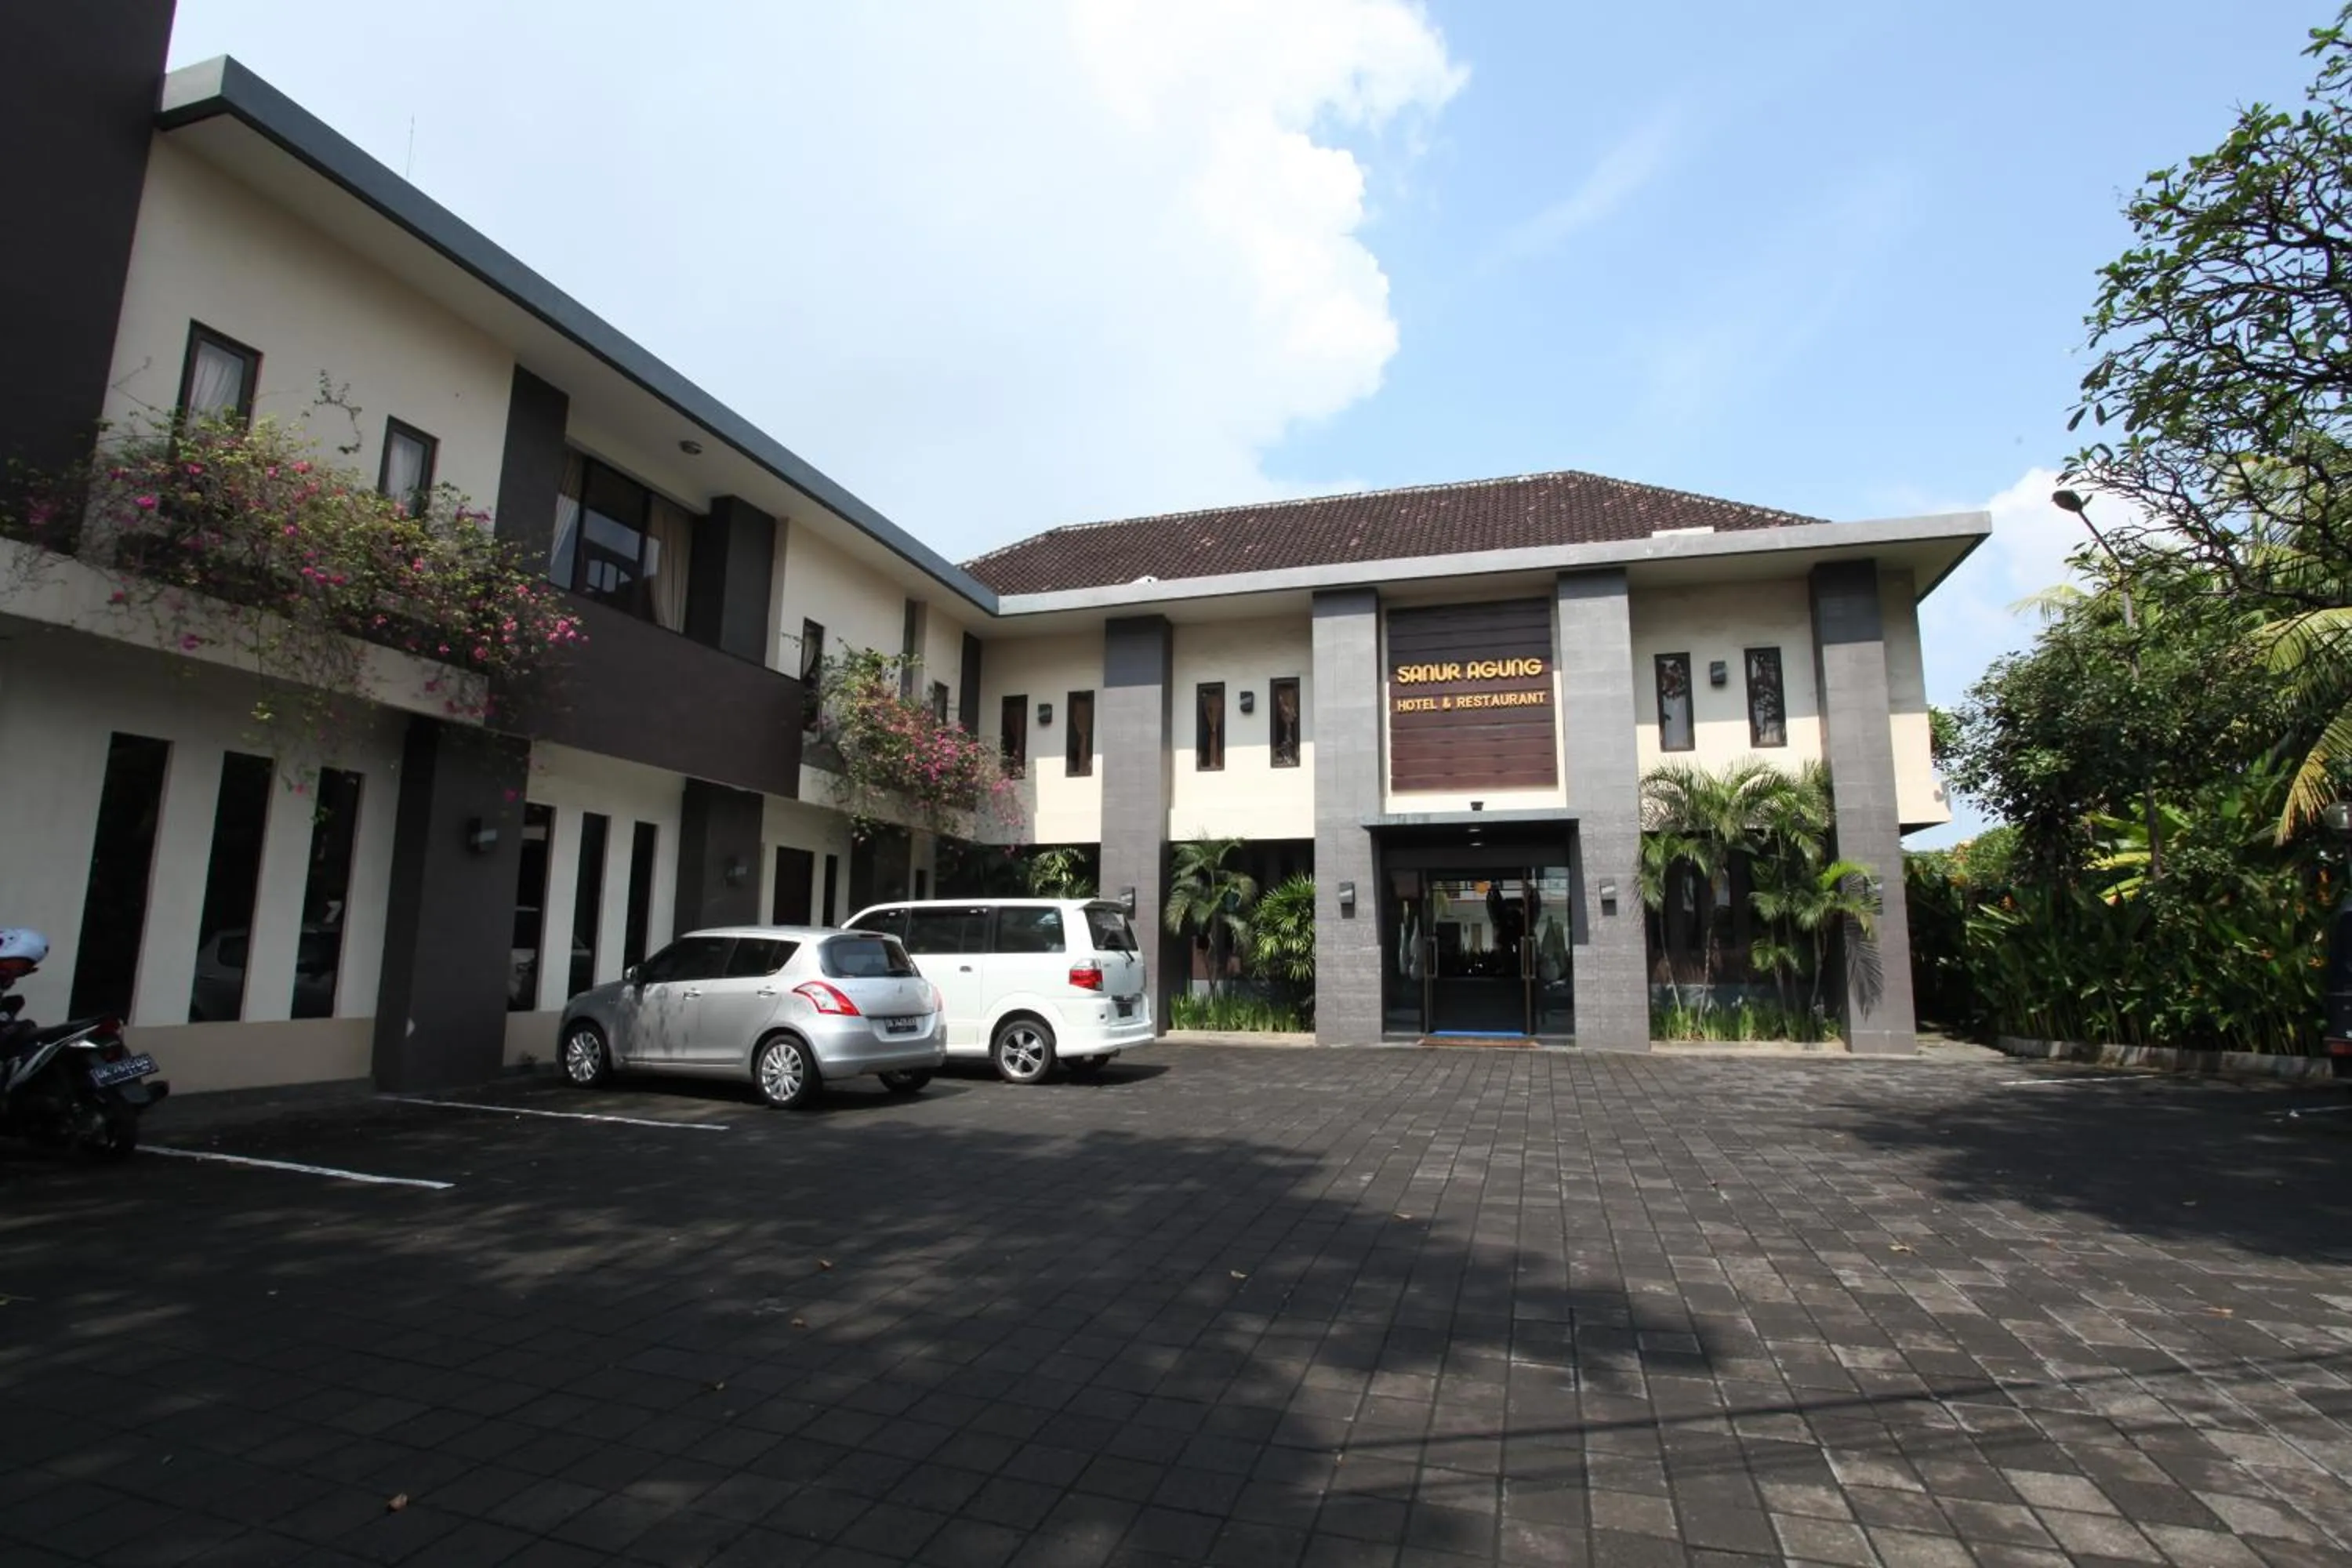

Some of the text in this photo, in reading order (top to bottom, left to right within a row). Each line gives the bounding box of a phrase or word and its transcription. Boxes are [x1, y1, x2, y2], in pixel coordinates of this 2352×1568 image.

[1397, 658, 1543, 684] SANUR AGUNG
[1397, 691, 1546, 712] HOTEL & RESTAURANT
